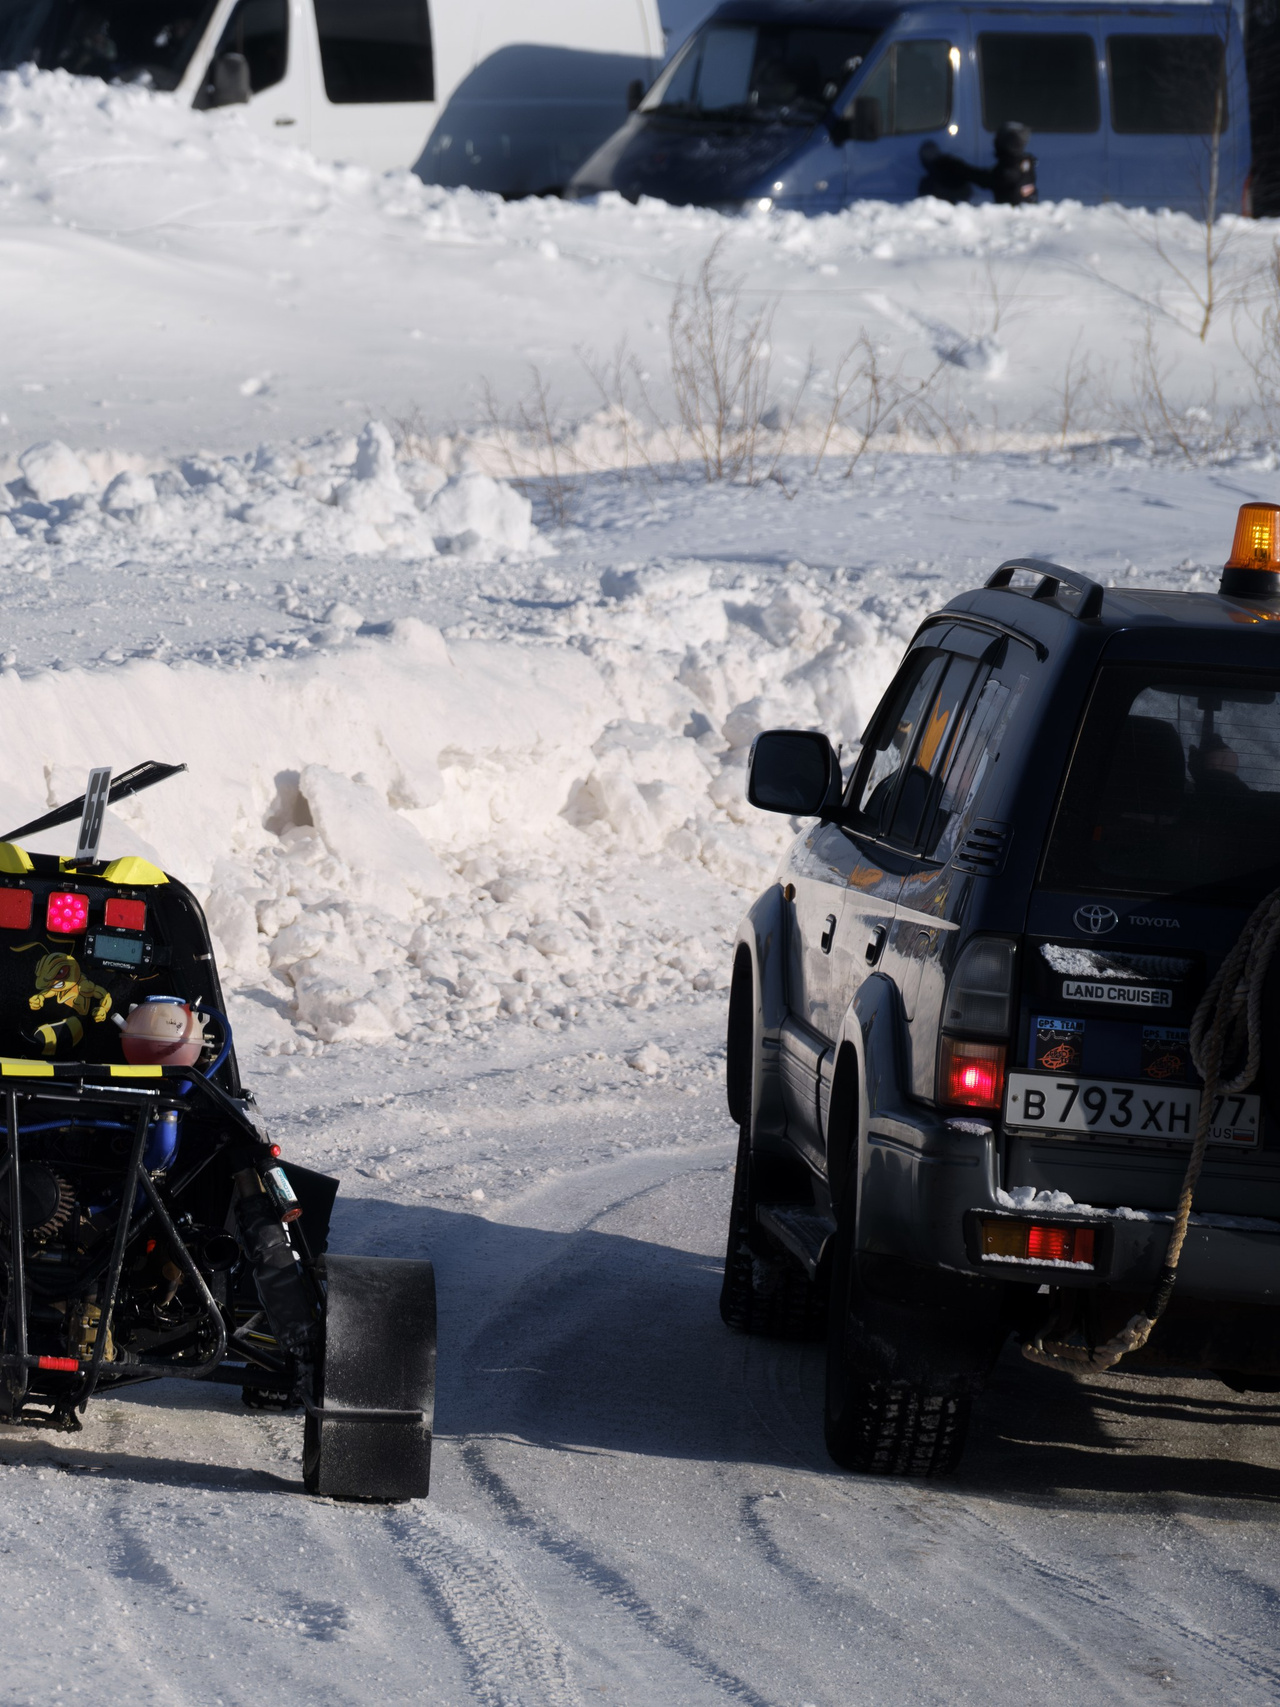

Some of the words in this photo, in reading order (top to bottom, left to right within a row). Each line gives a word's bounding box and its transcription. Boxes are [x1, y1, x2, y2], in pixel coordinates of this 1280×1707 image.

[1128, 915, 1181, 929] TOYOTA
[1065, 983, 1105, 999] LAND
[1107, 987, 1170, 1006] CRUISER
[1061, 1021, 1084, 1031] TEAM
